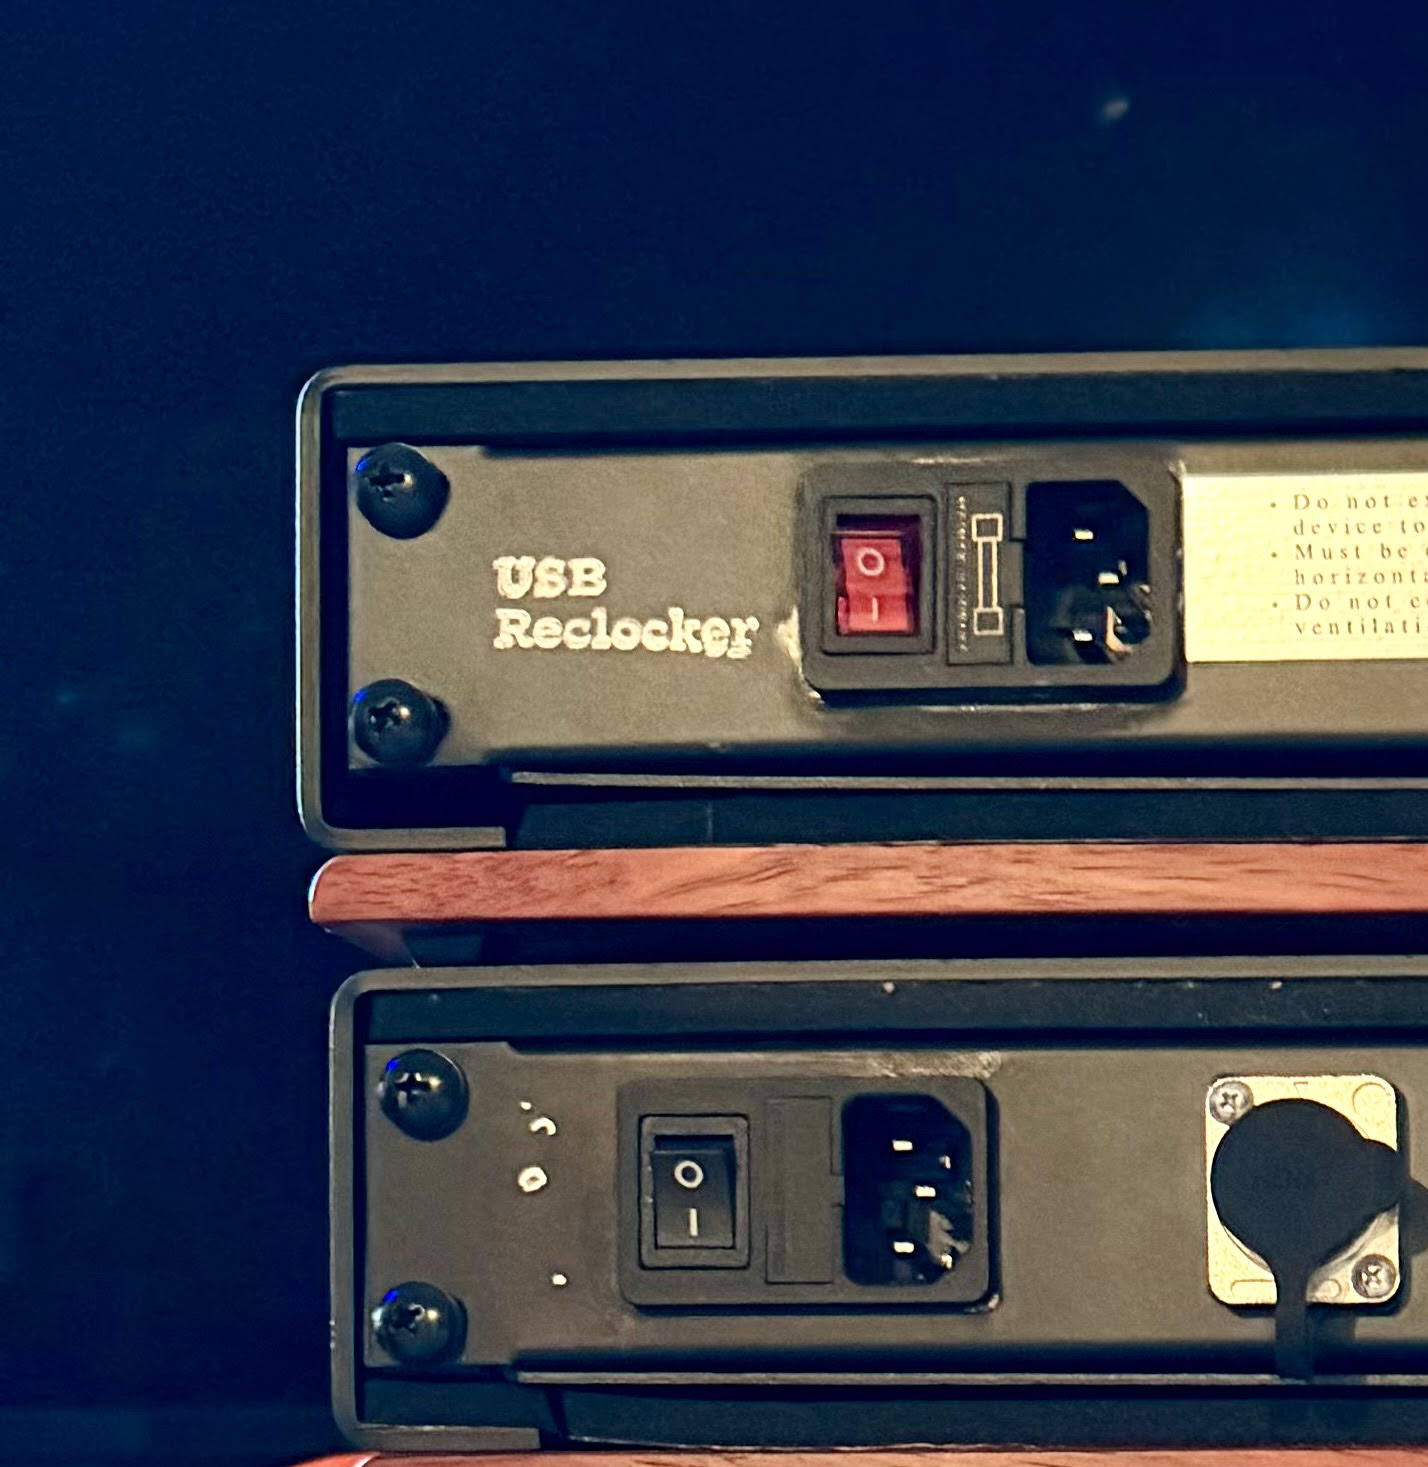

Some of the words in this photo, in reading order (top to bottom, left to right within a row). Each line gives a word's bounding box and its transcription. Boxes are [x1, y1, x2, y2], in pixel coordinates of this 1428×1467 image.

[1294, 493, 1329, 510] Do
[1347, 493, 1391, 510] not
[1294, 518, 1383, 536] device
[1400, 518, 1426, 533] to
[1295, 543, 1362, 561] Must
[1381, 542, 1408, 560] be
[491, 556, 608, 599] USB
[1295, 594, 1329, 611] Do
[1350, 595, 1392, 610] not
[492, 608, 760, 660] Reclocker
